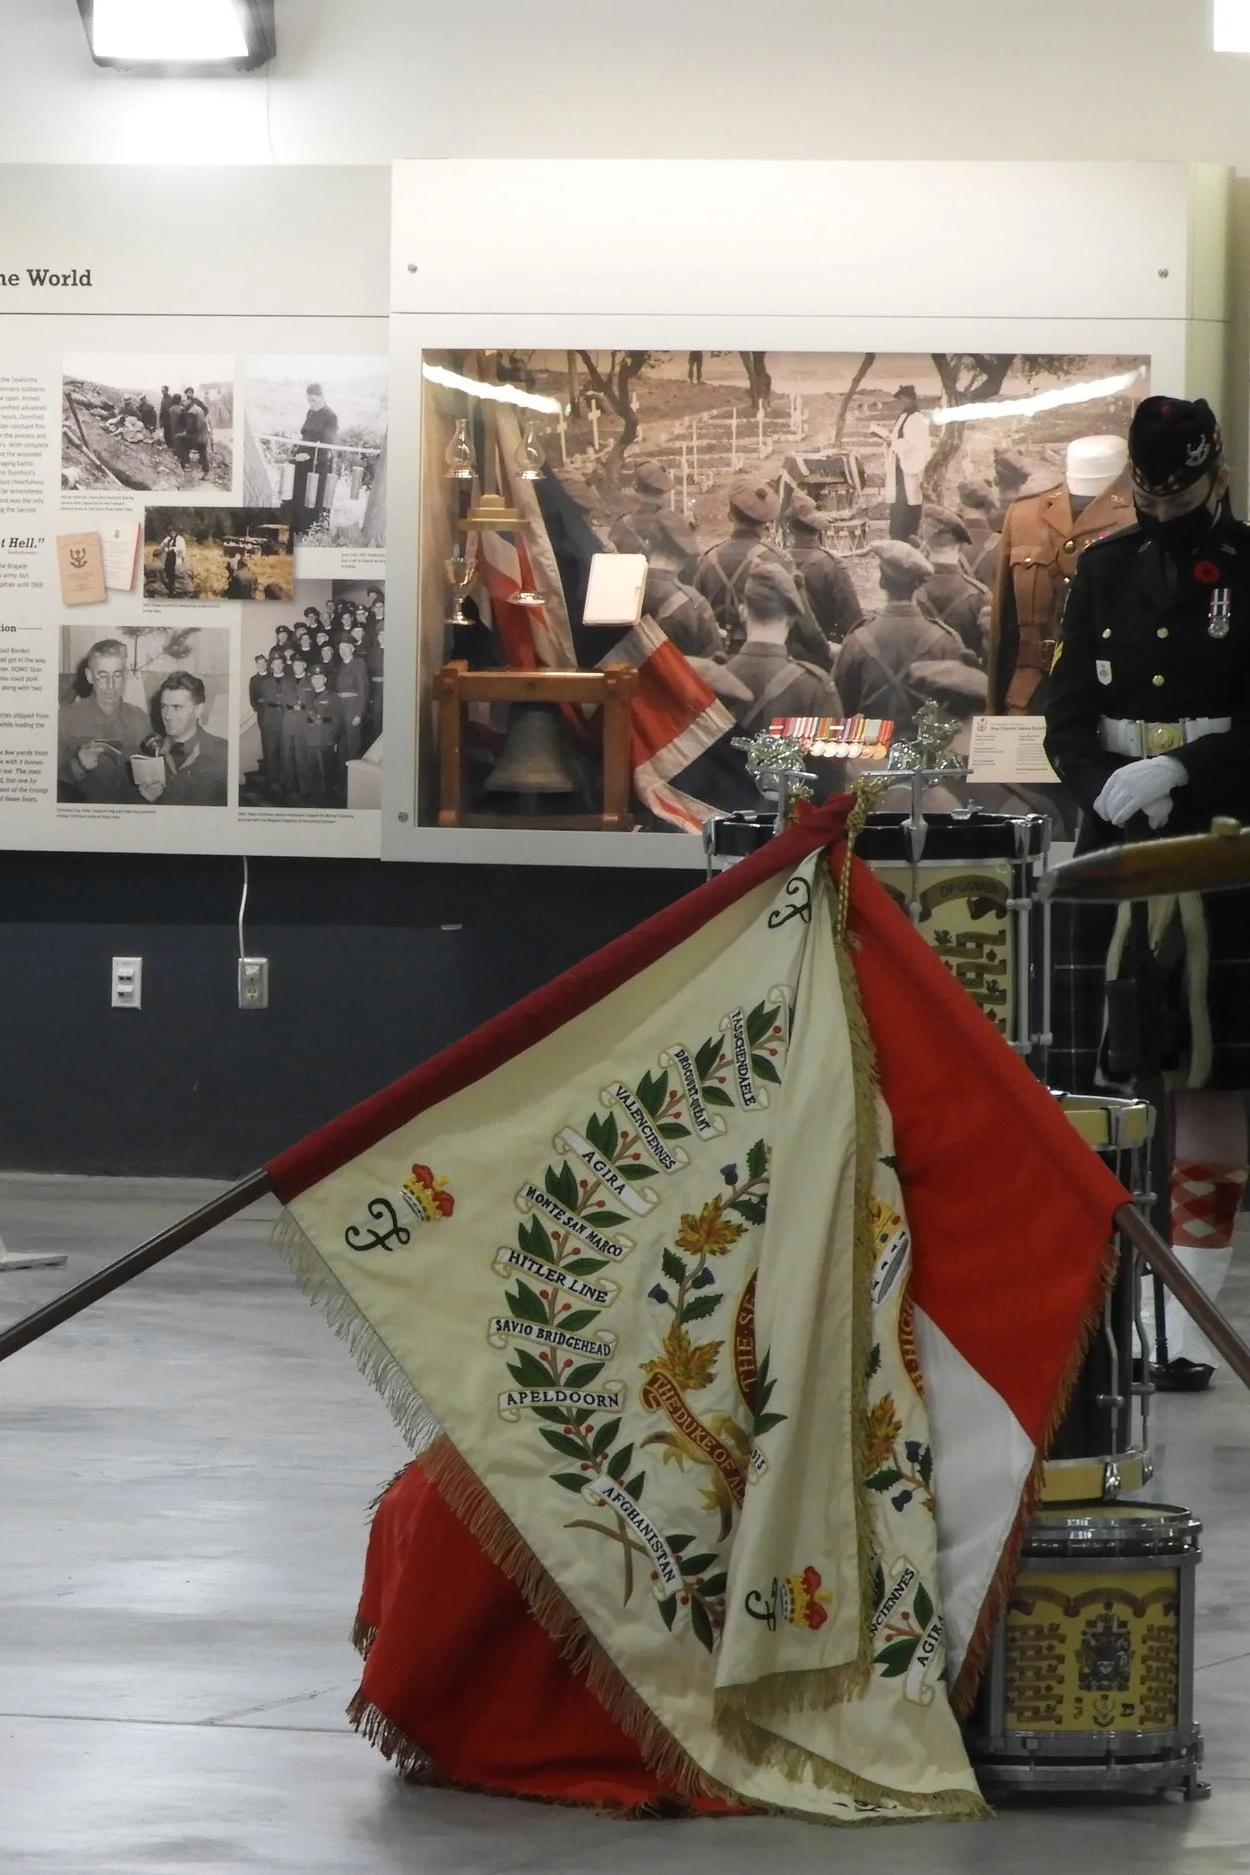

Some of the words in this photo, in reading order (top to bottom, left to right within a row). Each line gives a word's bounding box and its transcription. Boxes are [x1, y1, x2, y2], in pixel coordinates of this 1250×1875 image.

[27, 269, 92, 287] World
[731, 1010, 756, 1107] PASSCHENDAELE
[615, 1085, 677, 1170] VALENCIENNES
[582, 1151, 626, 1195] AGIRA
[526, 1186, 566, 1221] MONTE
[562, 1216, 587, 1234] SAN
[586, 1230, 623, 1257] MARCO
[509, 1250, 567, 1285] HITLER
[569, 1279, 608, 1303] LINE
[496, 1319, 533, 1336] SAVIO
[536, 1329, 611, 1357] BRIDGEHEAD
[507, 1390, 620, 1408] APELDOORN
[654, 1374, 681, 1415] THE
[674, 1409, 716, 1451] DUKE
[714, 1448, 735, 1474] OF
[602, 1487, 676, 1583] AFGHANISTAN
